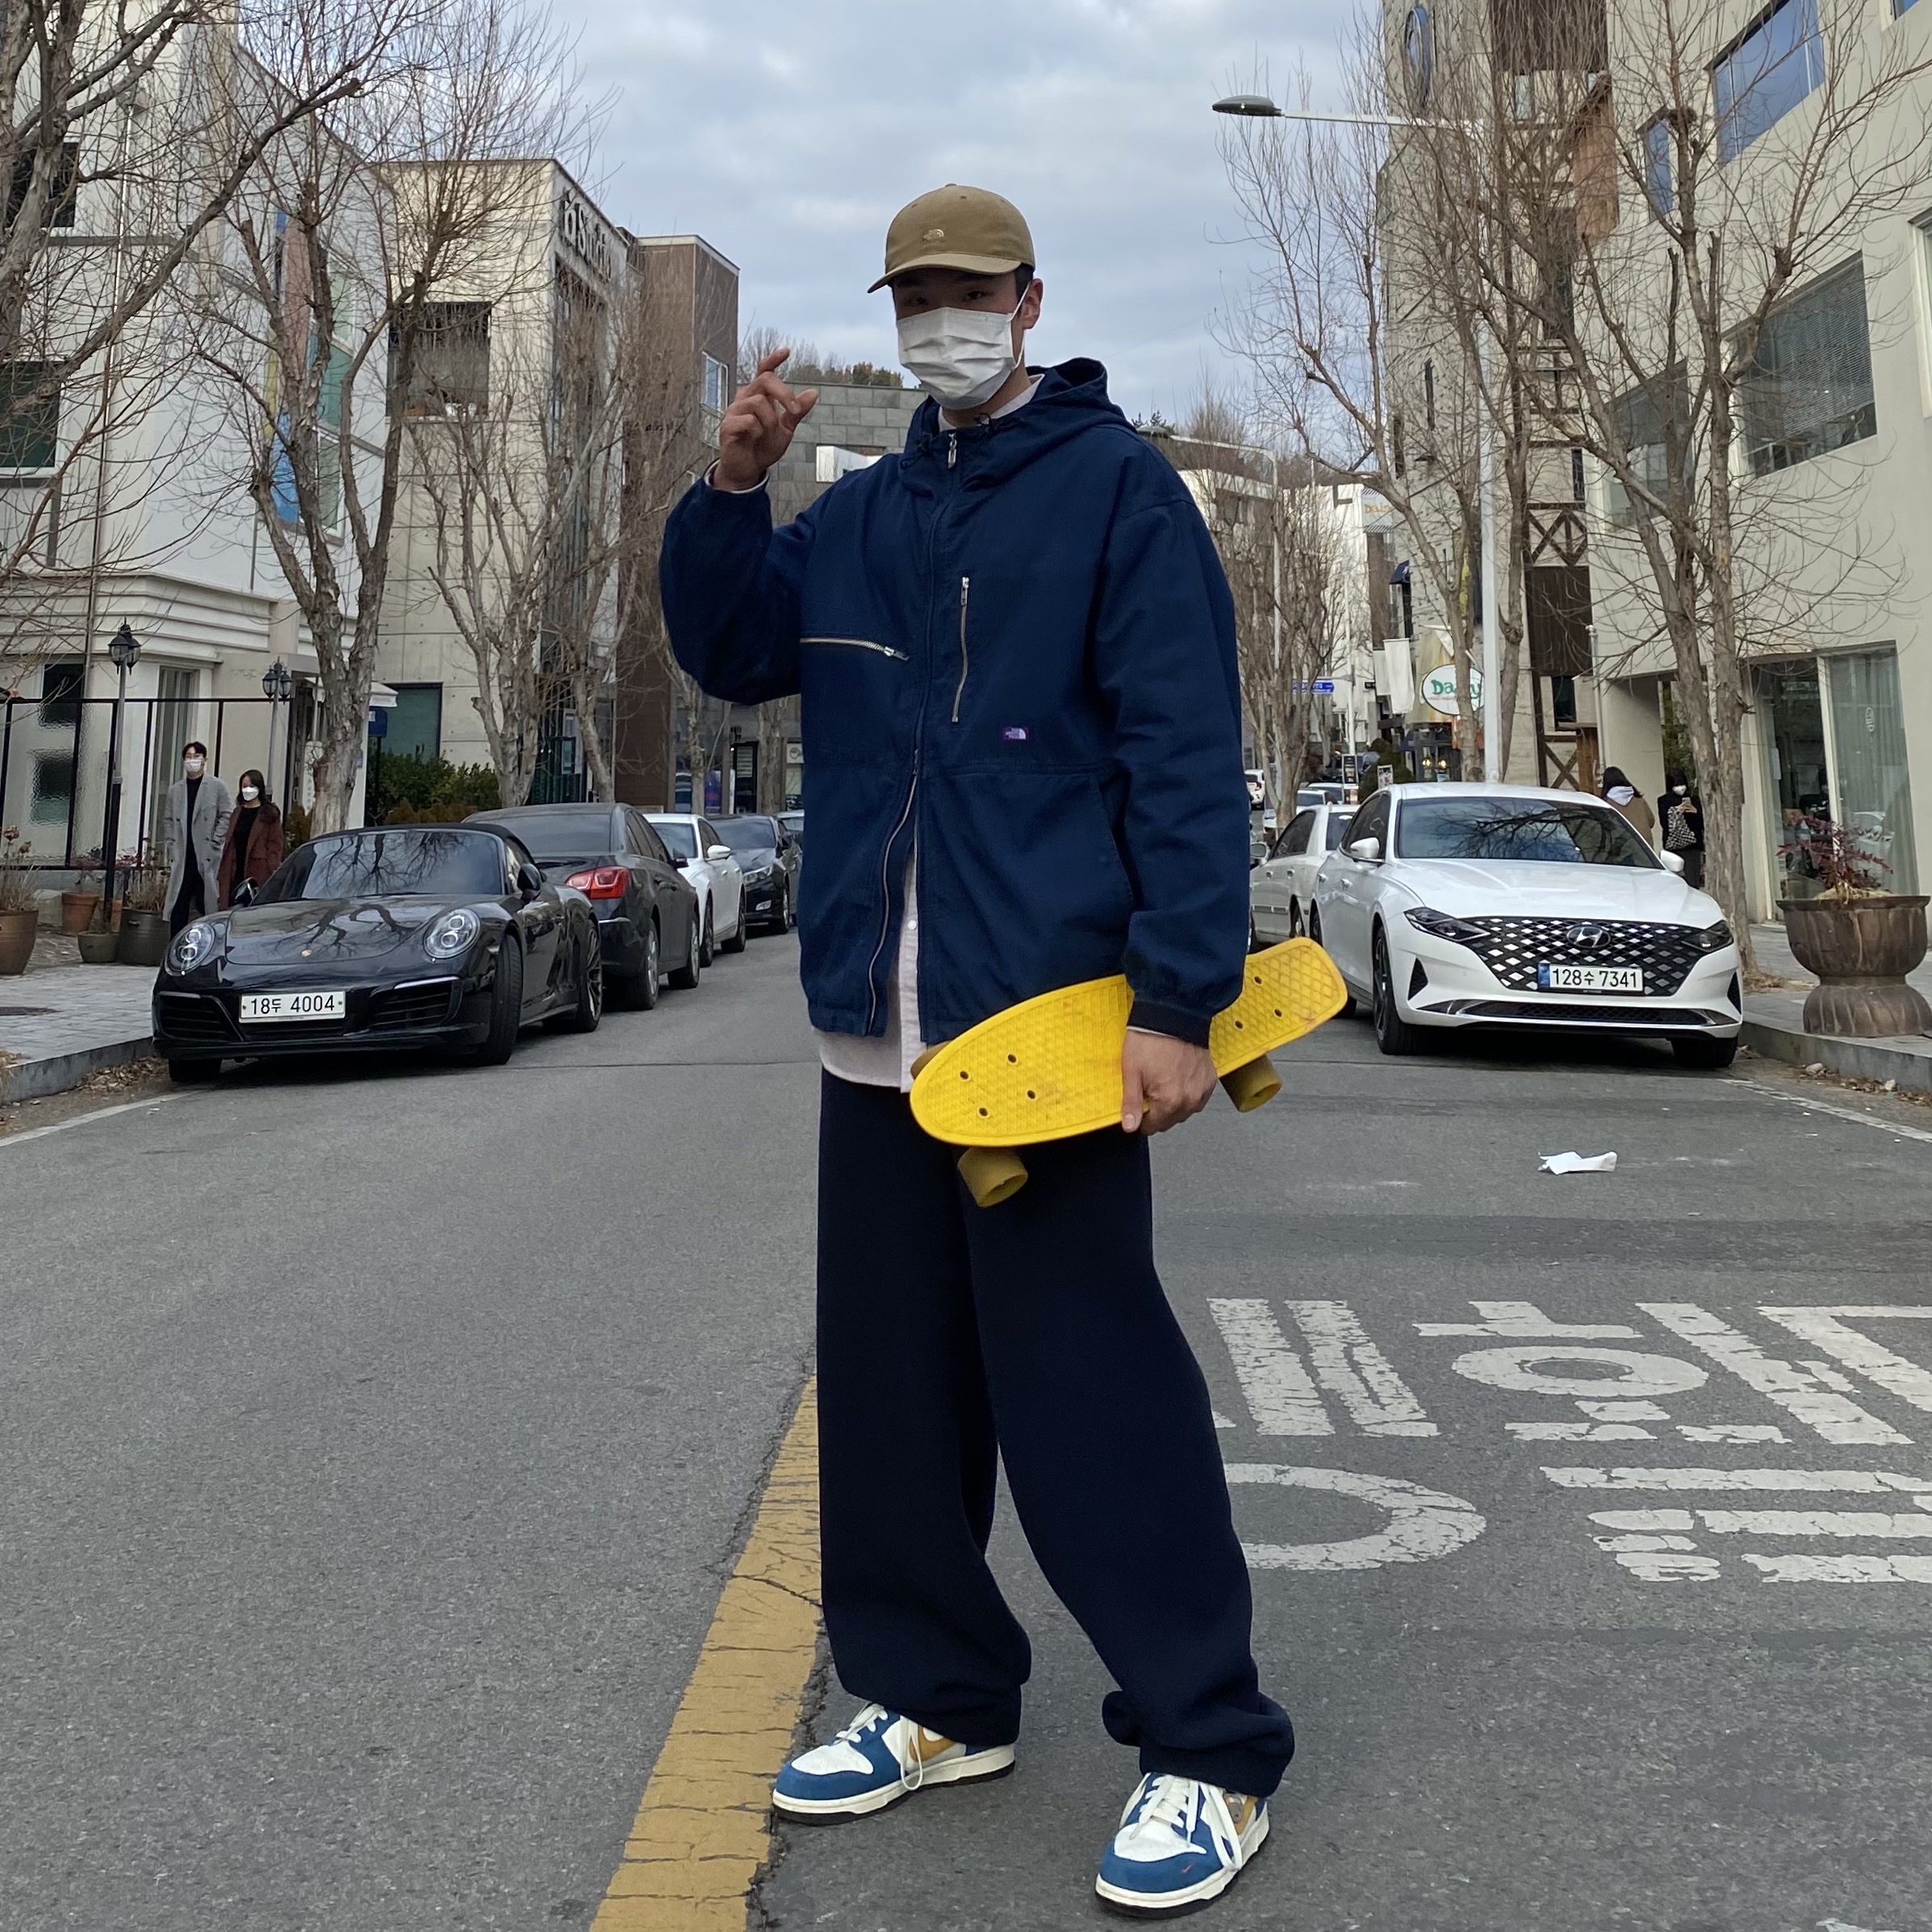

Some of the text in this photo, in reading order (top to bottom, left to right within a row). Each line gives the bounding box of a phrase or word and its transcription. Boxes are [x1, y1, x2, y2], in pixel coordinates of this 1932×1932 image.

[1431, 680, 1481, 699] Day
[1553, 968, 1637, 989] 128수 7341
[251, 994, 335, 1015] 18두 4004
